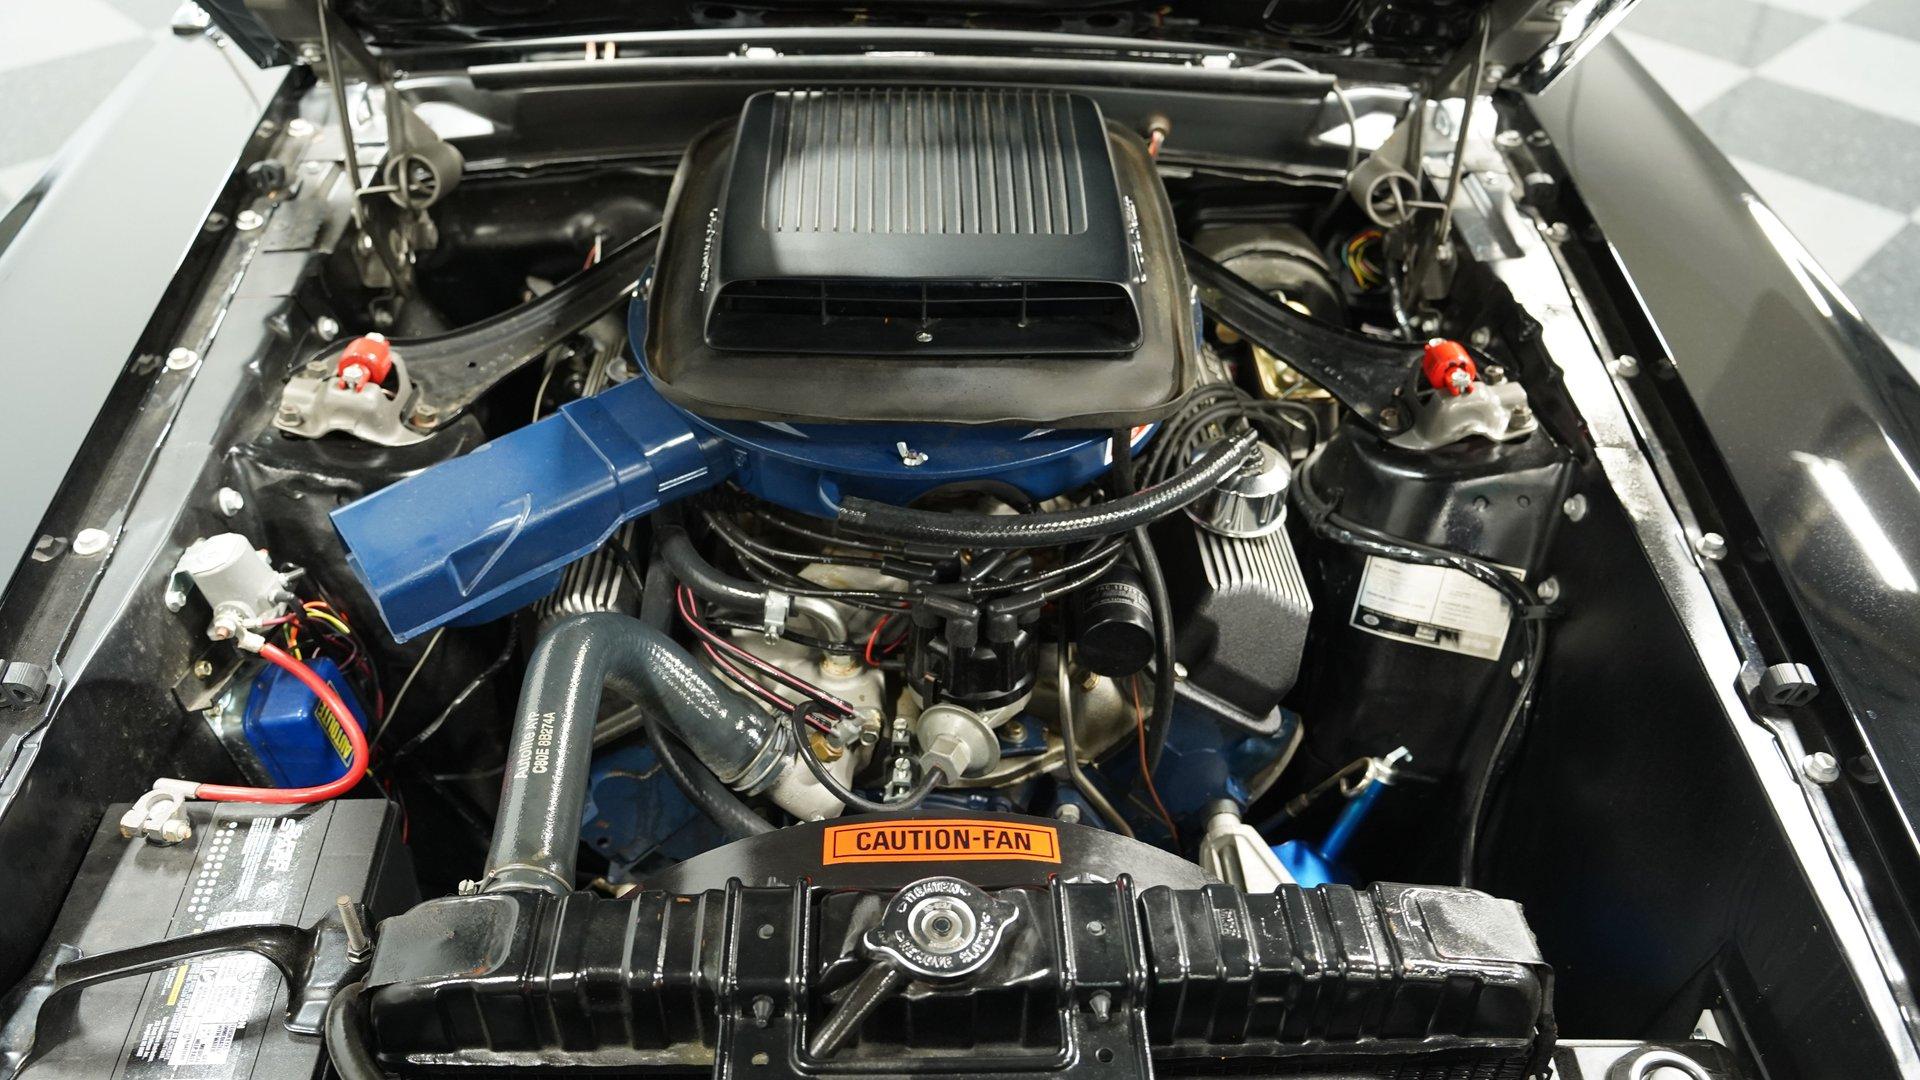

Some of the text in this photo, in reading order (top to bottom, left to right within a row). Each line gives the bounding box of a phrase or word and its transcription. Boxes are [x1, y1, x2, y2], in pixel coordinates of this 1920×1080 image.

[538, 712, 556, 746] 8B274A
[514, 732, 535, 778] Autolite
[856, 829, 1031, 851] CAUTION-FAN
